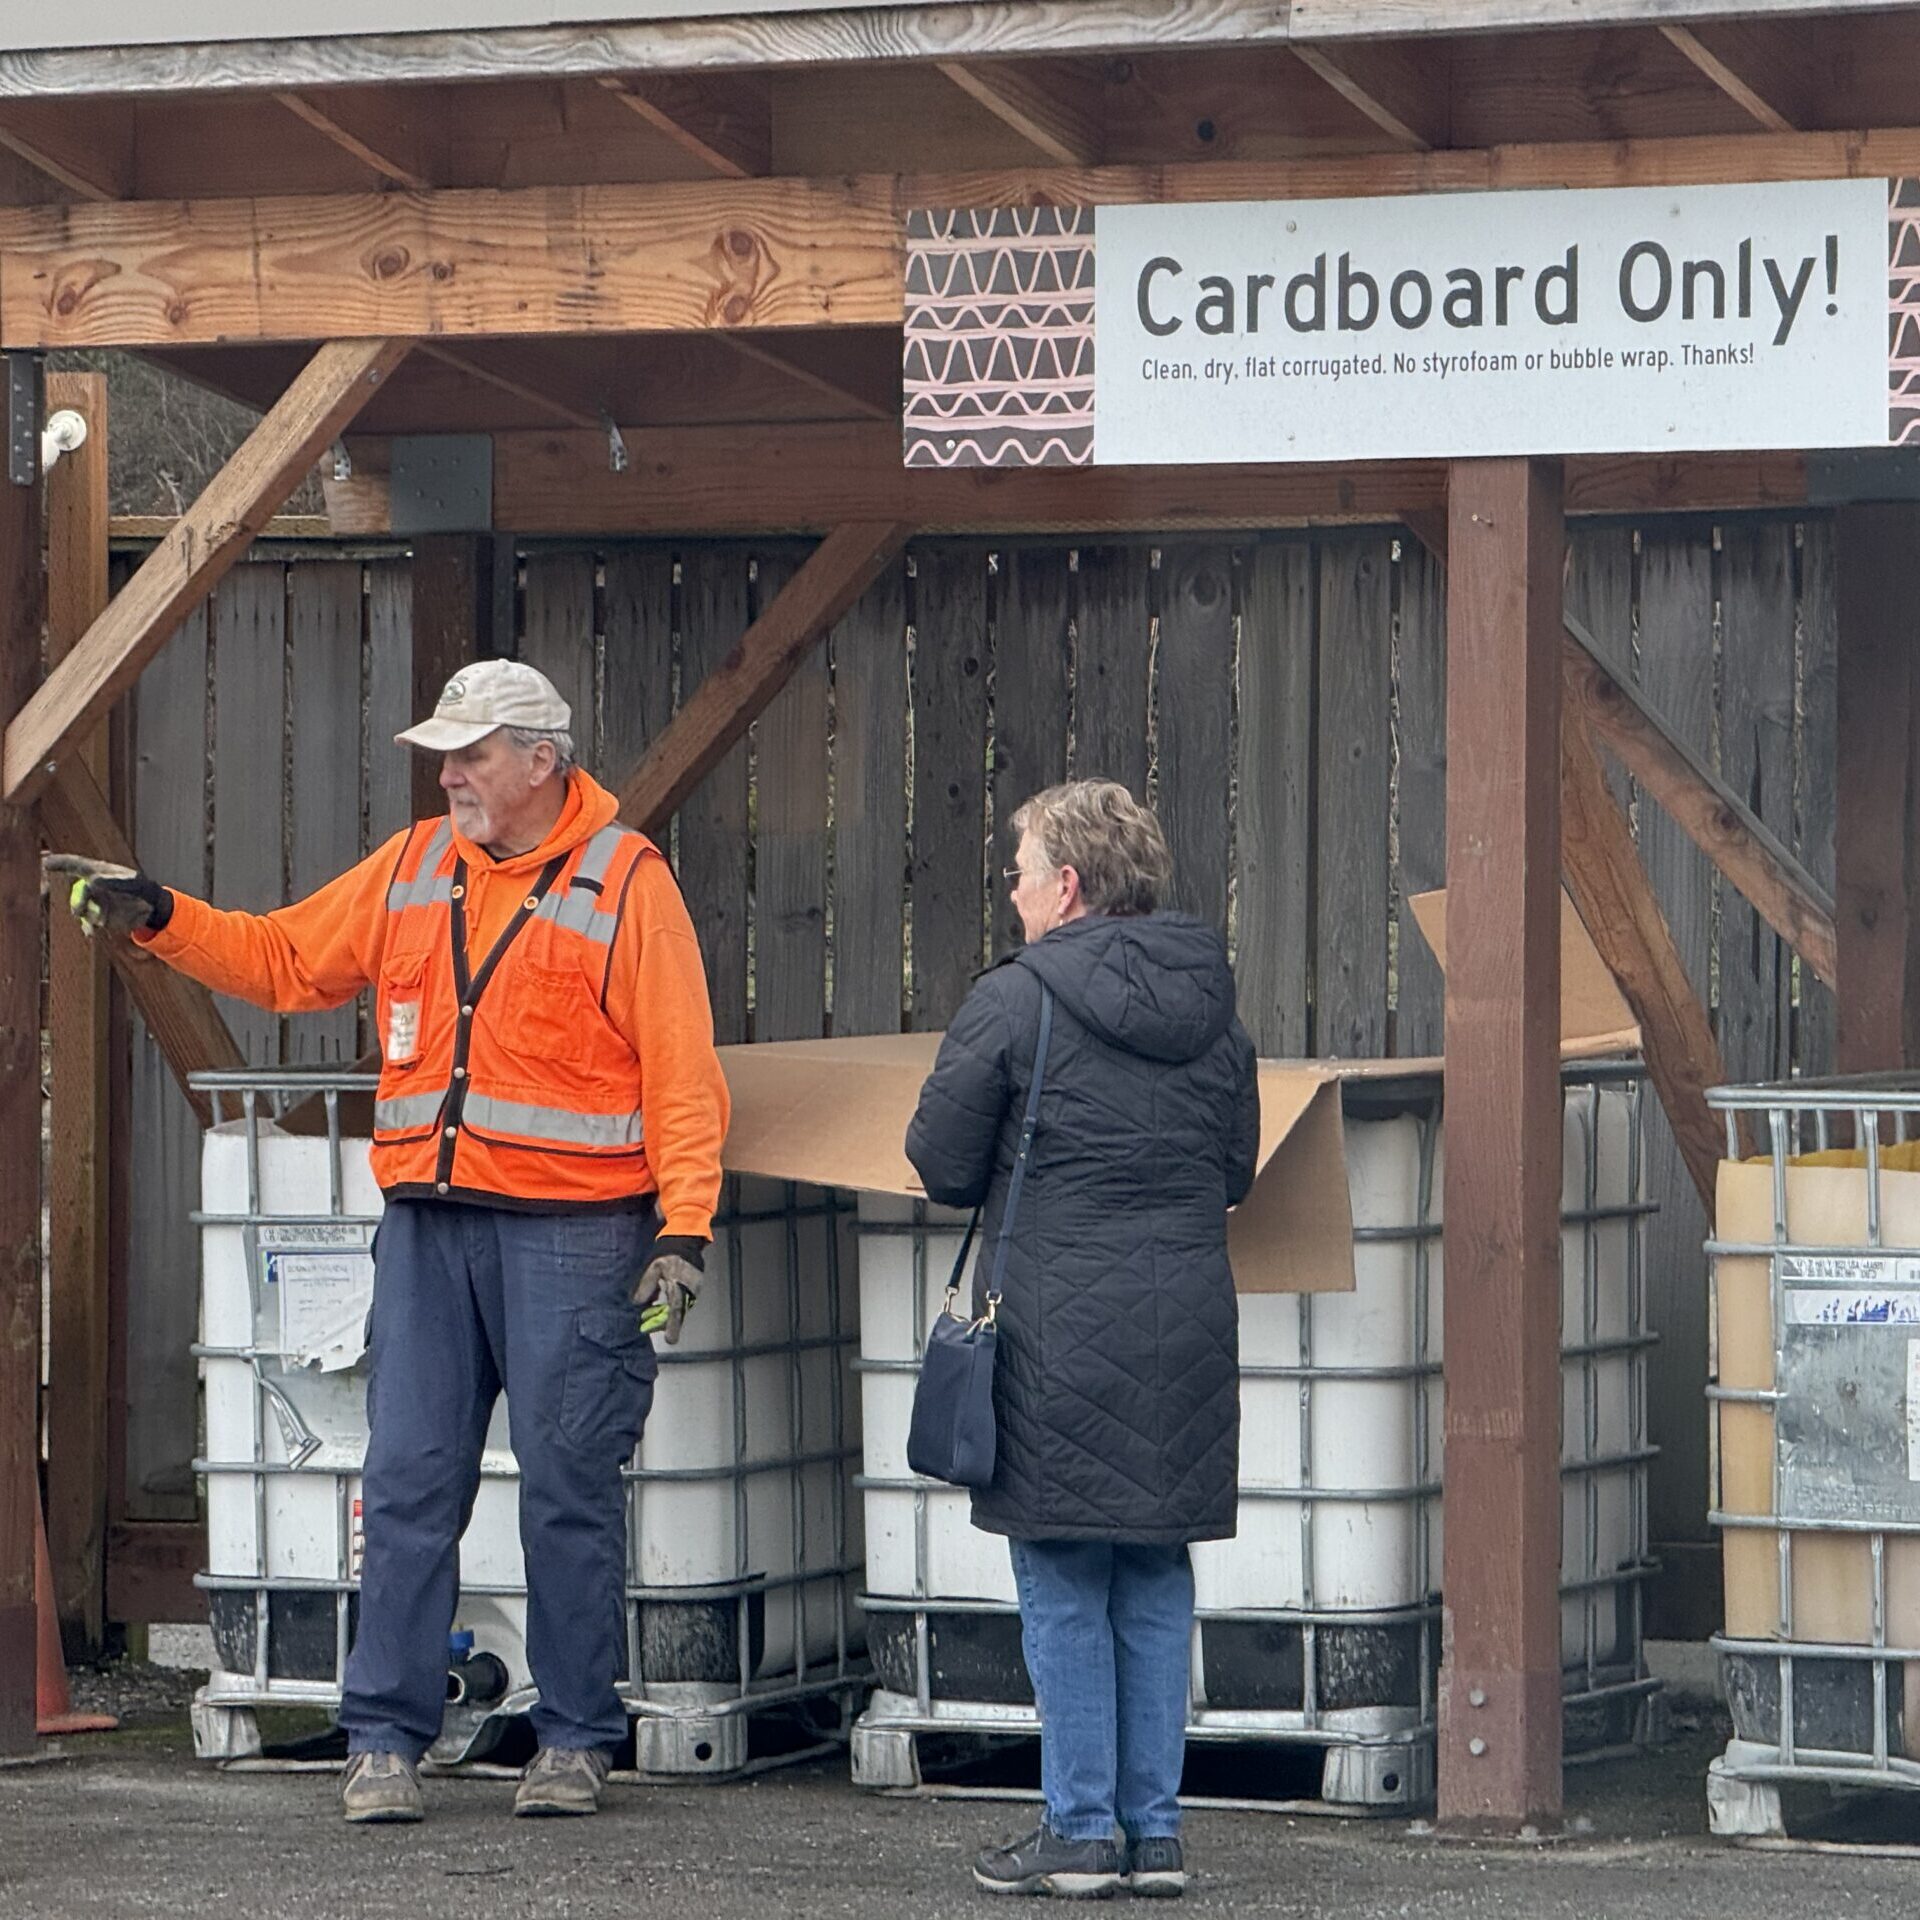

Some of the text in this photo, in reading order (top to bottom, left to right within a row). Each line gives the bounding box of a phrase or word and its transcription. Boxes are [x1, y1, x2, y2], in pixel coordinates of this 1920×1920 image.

[1137, 234, 1838, 346] Cardboard Only!
[1142, 342, 1754, 385] Clean, dry, flat corrugated. No styrofoam or bubble wrap. Thanks!
